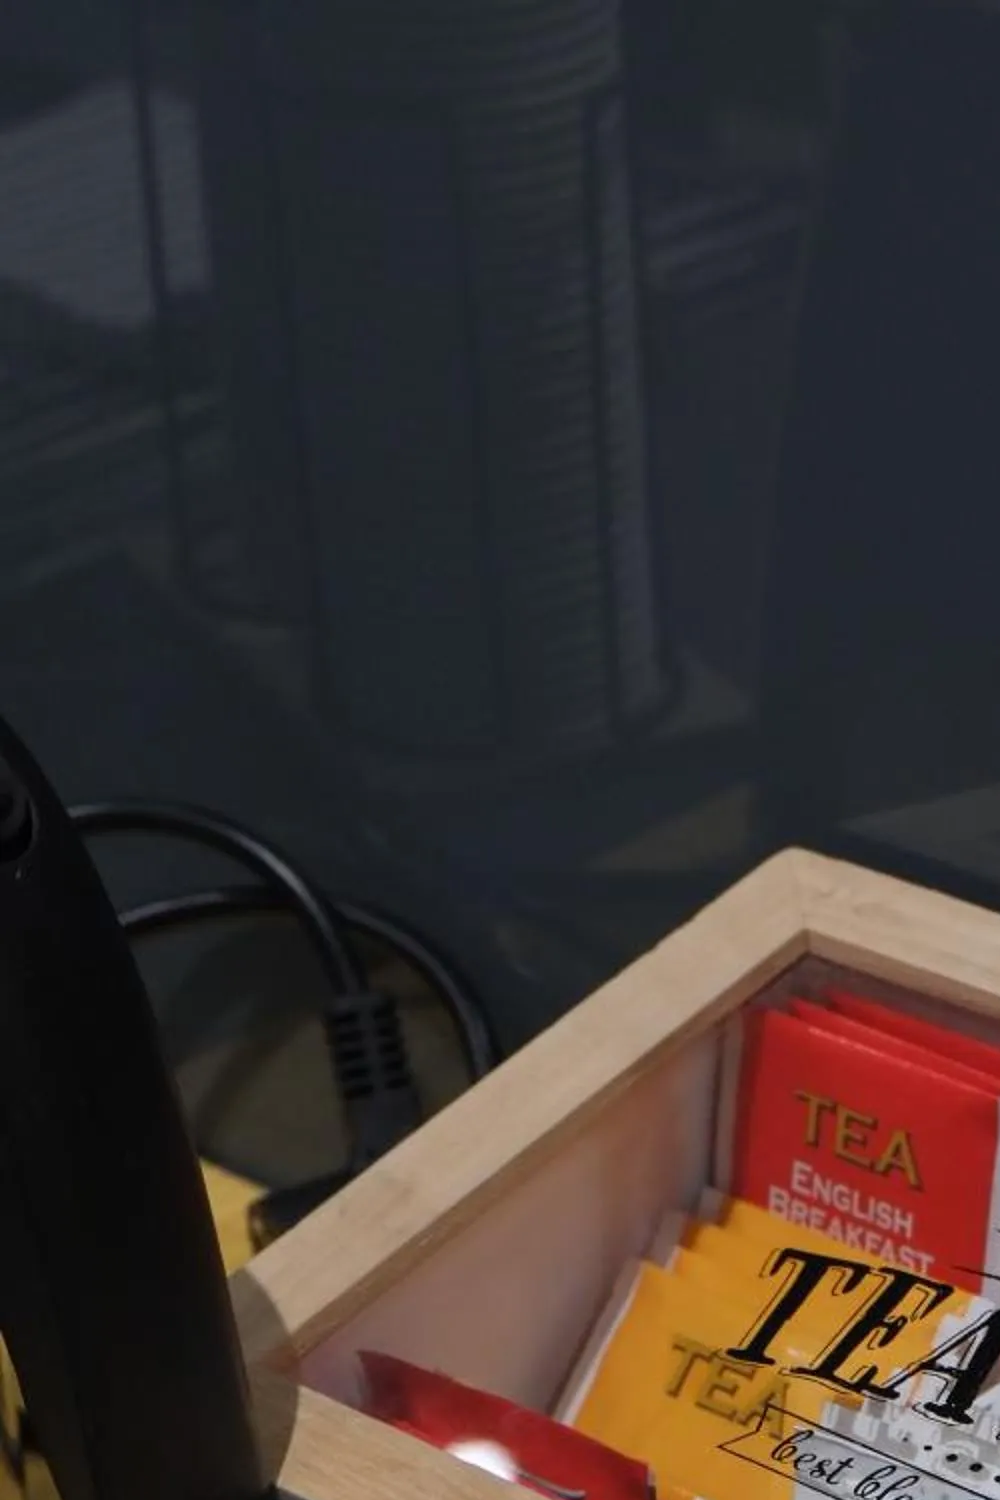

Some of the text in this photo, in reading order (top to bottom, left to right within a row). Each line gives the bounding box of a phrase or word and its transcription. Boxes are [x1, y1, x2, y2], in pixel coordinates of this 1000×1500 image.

[794, 1090, 924, 1191] TEA
[768, 1184, 936, 1277] BREAKFAST
[791, 1159, 914, 1239] ENGLISH
[666, 1334, 790, 1440] TEA
[771, 1429, 853, 1486] best
